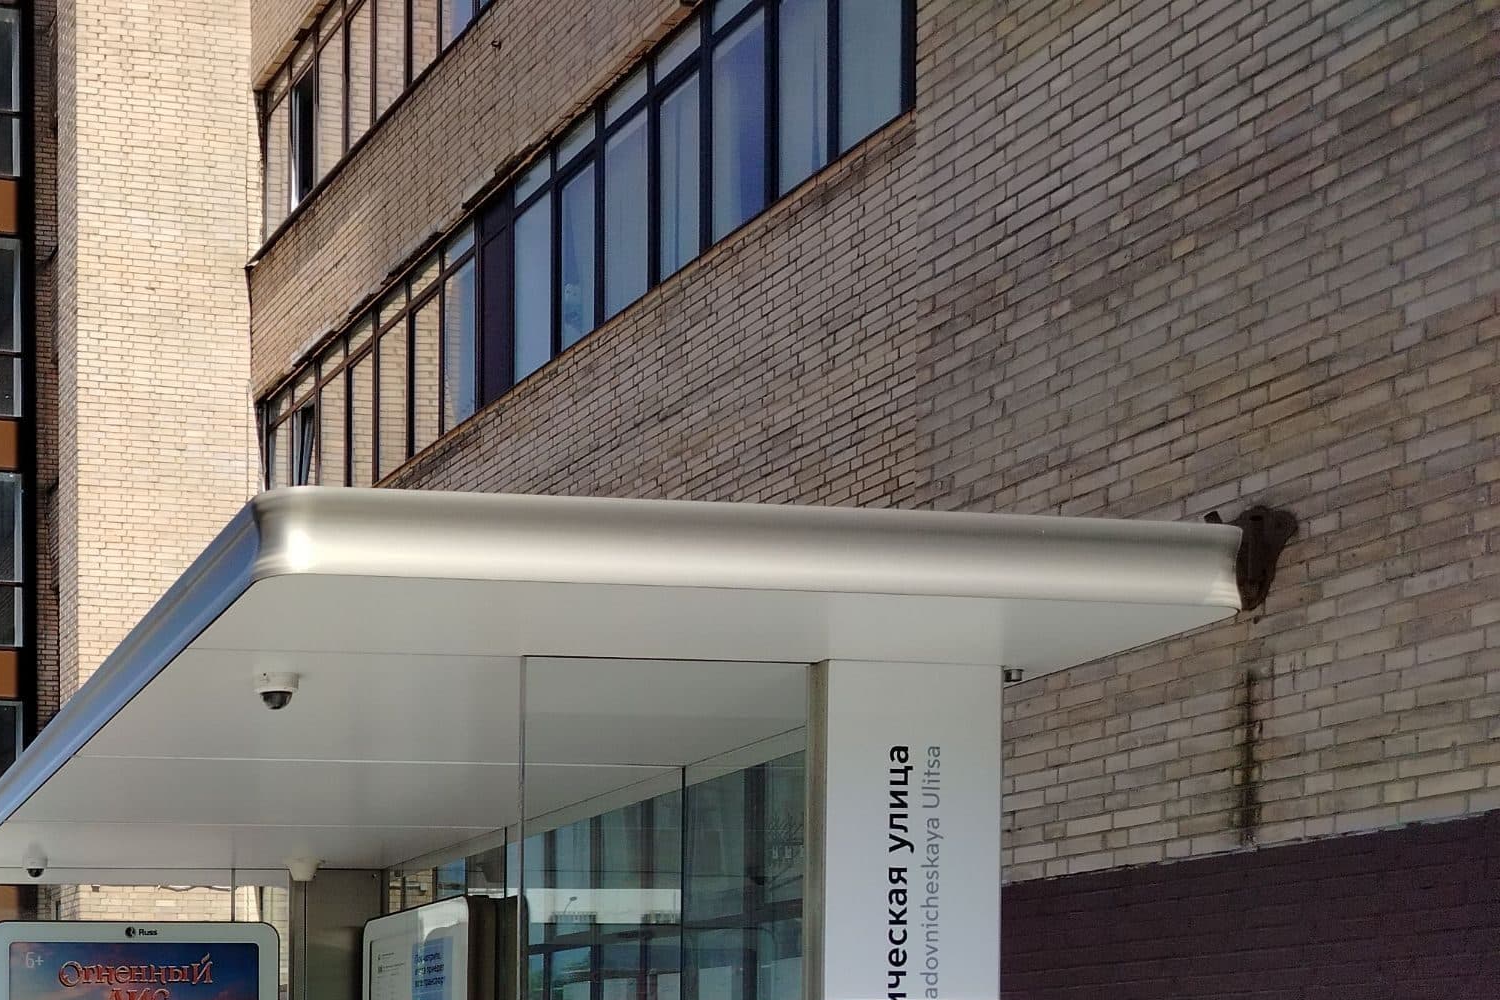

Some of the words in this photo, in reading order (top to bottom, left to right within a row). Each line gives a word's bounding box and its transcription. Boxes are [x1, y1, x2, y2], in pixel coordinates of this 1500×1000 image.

[888, 745, 915, 854] улица
[921, 745, 941, 809] Ulitsa
[25, 951, 45, 969] 6+
